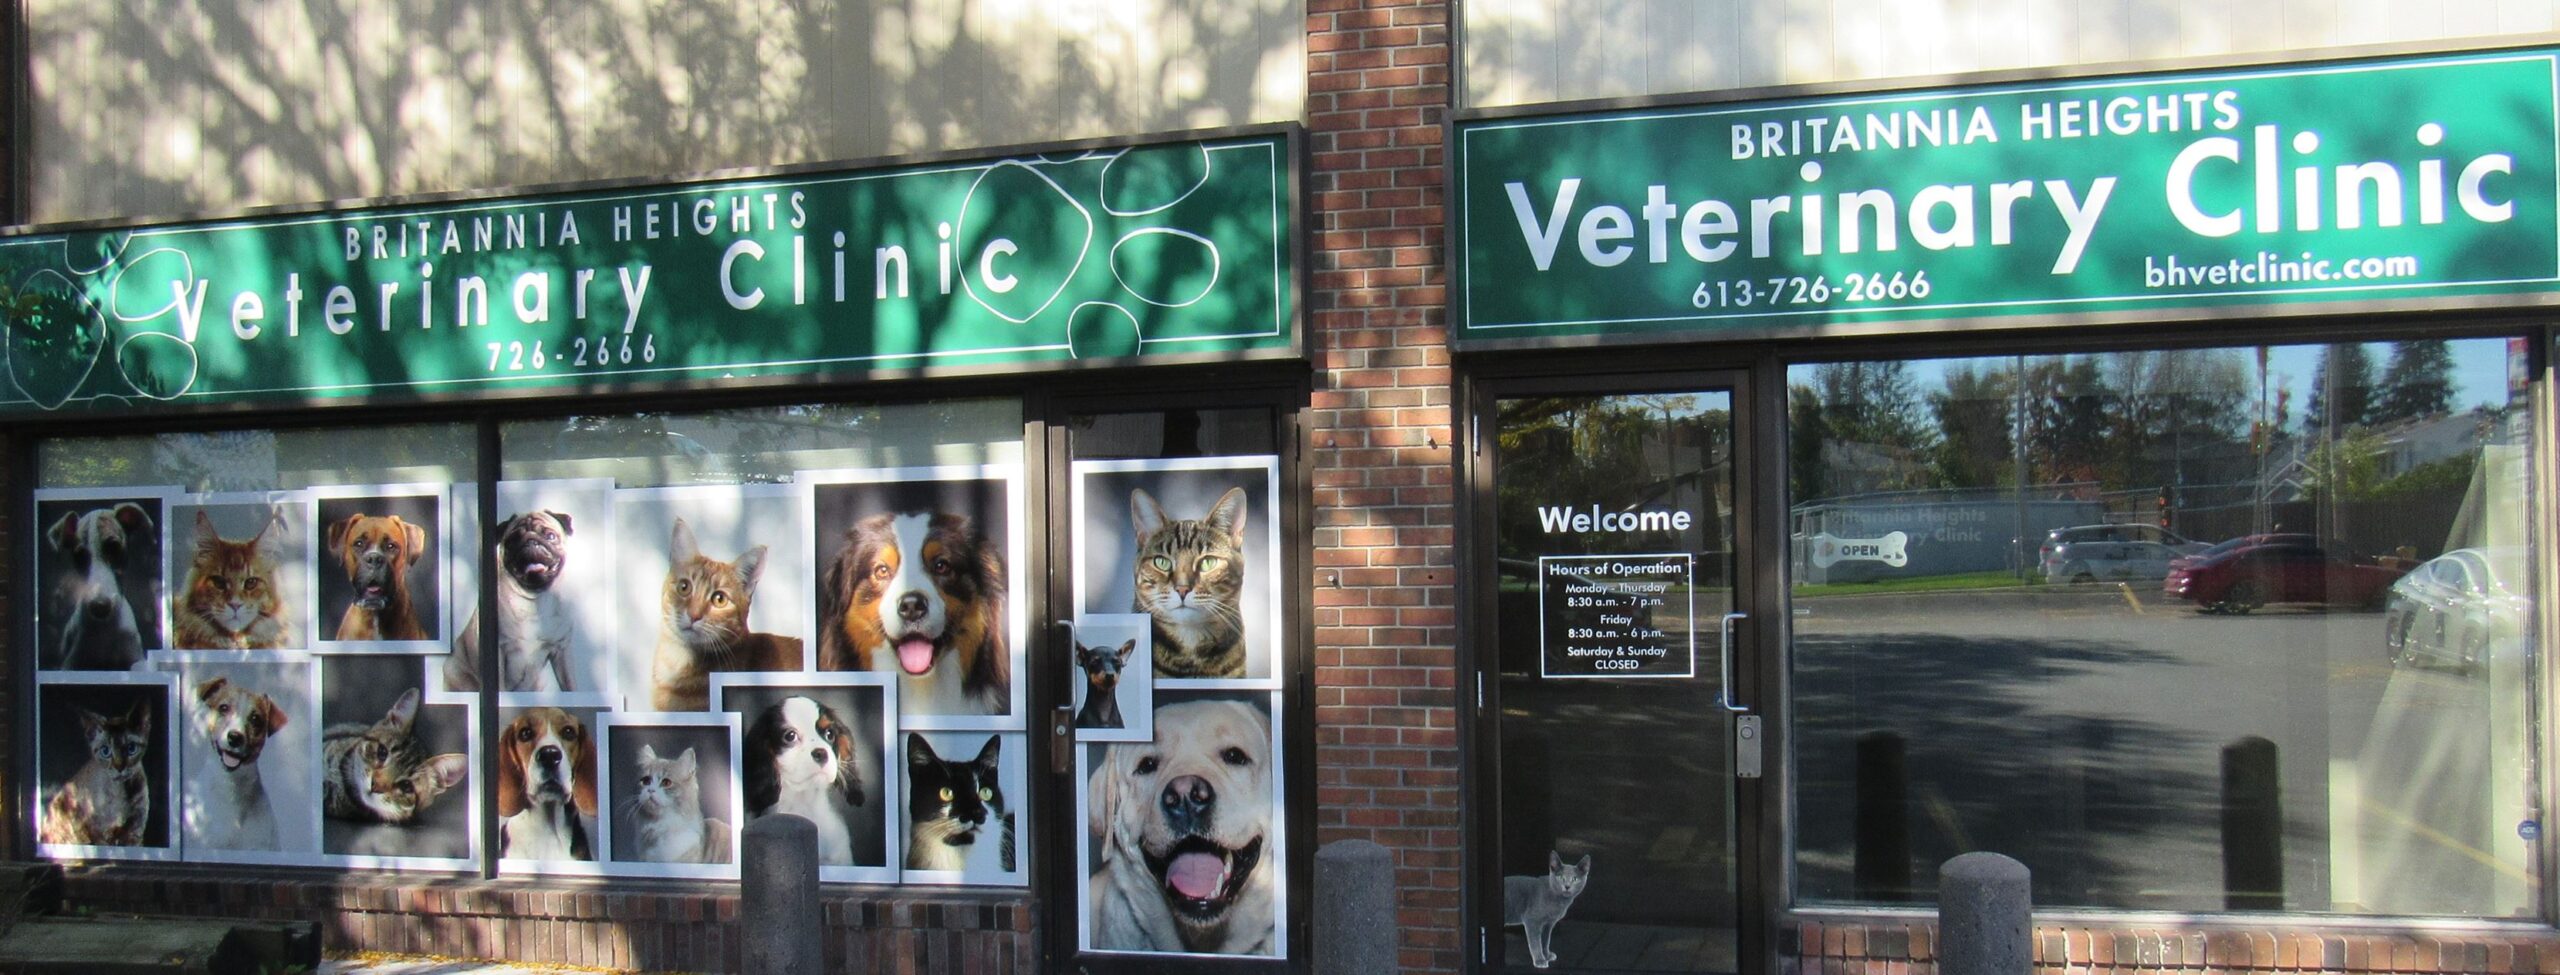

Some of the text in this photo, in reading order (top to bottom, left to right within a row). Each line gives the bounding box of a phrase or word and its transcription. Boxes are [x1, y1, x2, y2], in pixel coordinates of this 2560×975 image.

[1731, 90, 2241, 161] BRITANNIA HEIGHTS
[1503, 122, 2514, 274] Veterinary Clinic
[346, 190, 807, 261] BRITANNIA HEIGHTS
[2145, 251, 2417, 288] bhvetclinic.com
[171, 221, 1019, 342] Veterinary Clinic
[1692, 270, 1930, 309] 613-726-2666
[487, 334, 657, 372] 726-2666
[1538, 504, 1691, 533] Welcome
[1841, 545, 1879, 556] OPEN
[1550, 561, 1682, 577] Hours of Operation
[1565, 584, 1608, 595] Monday
[1619, 583, 1666, 594] Thursday
[1567, 597, 1592, 607] 8:30
[1595, 598, 1619, 607] a.m.
[1630, 597, 1637, 606] 7
[1640, 598, 1664, 608] p.m.
[1600, 614, 1632, 626] Friday
[1568, 628, 1593, 638] 8:30
[1595, 630, 1619, 638] a.m.
[1630, 628, 1637, 637] 6
[1641, 629, 1665, 640] p.m.
[1567, 646, 1667, 658] Saturday & Sunday
[1595, 659, 1639, 670] CLOSED
